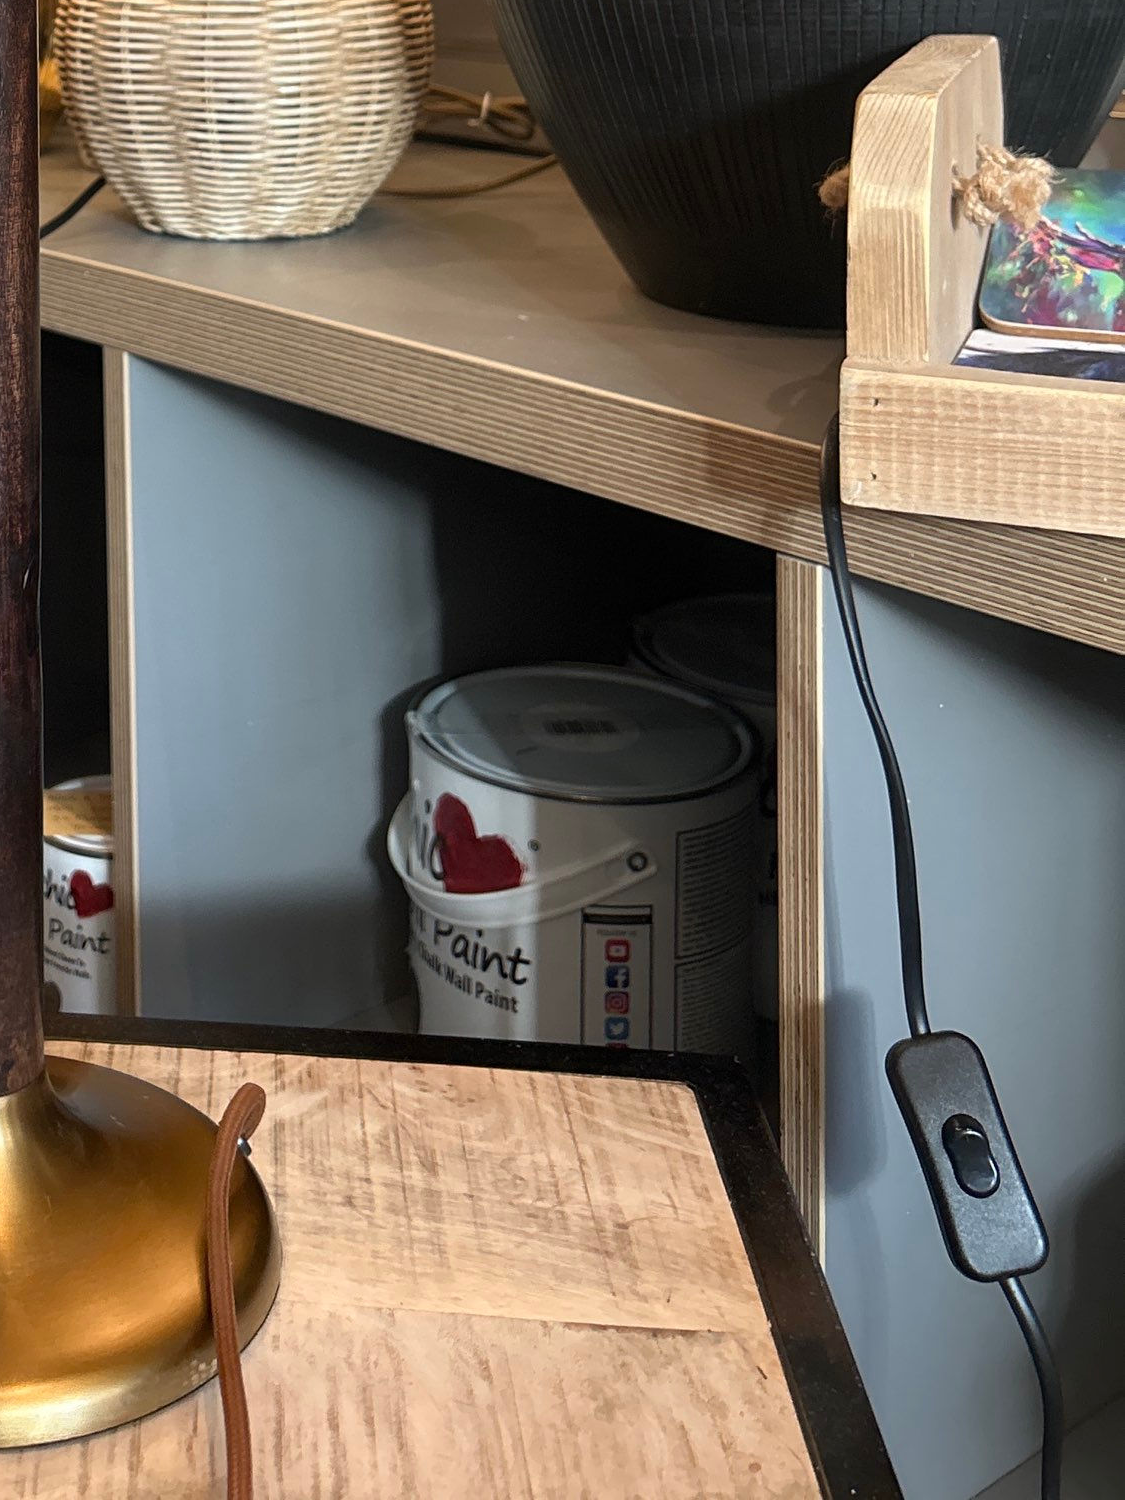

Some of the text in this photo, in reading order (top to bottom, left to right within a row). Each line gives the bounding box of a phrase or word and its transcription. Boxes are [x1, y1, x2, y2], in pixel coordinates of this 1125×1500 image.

[48, 917, 112, 955] Paint
[432, 918, 531, 986] Paint
[443, 964, 473, 996] Wall
[475, 981, 519, 1014] Paint
